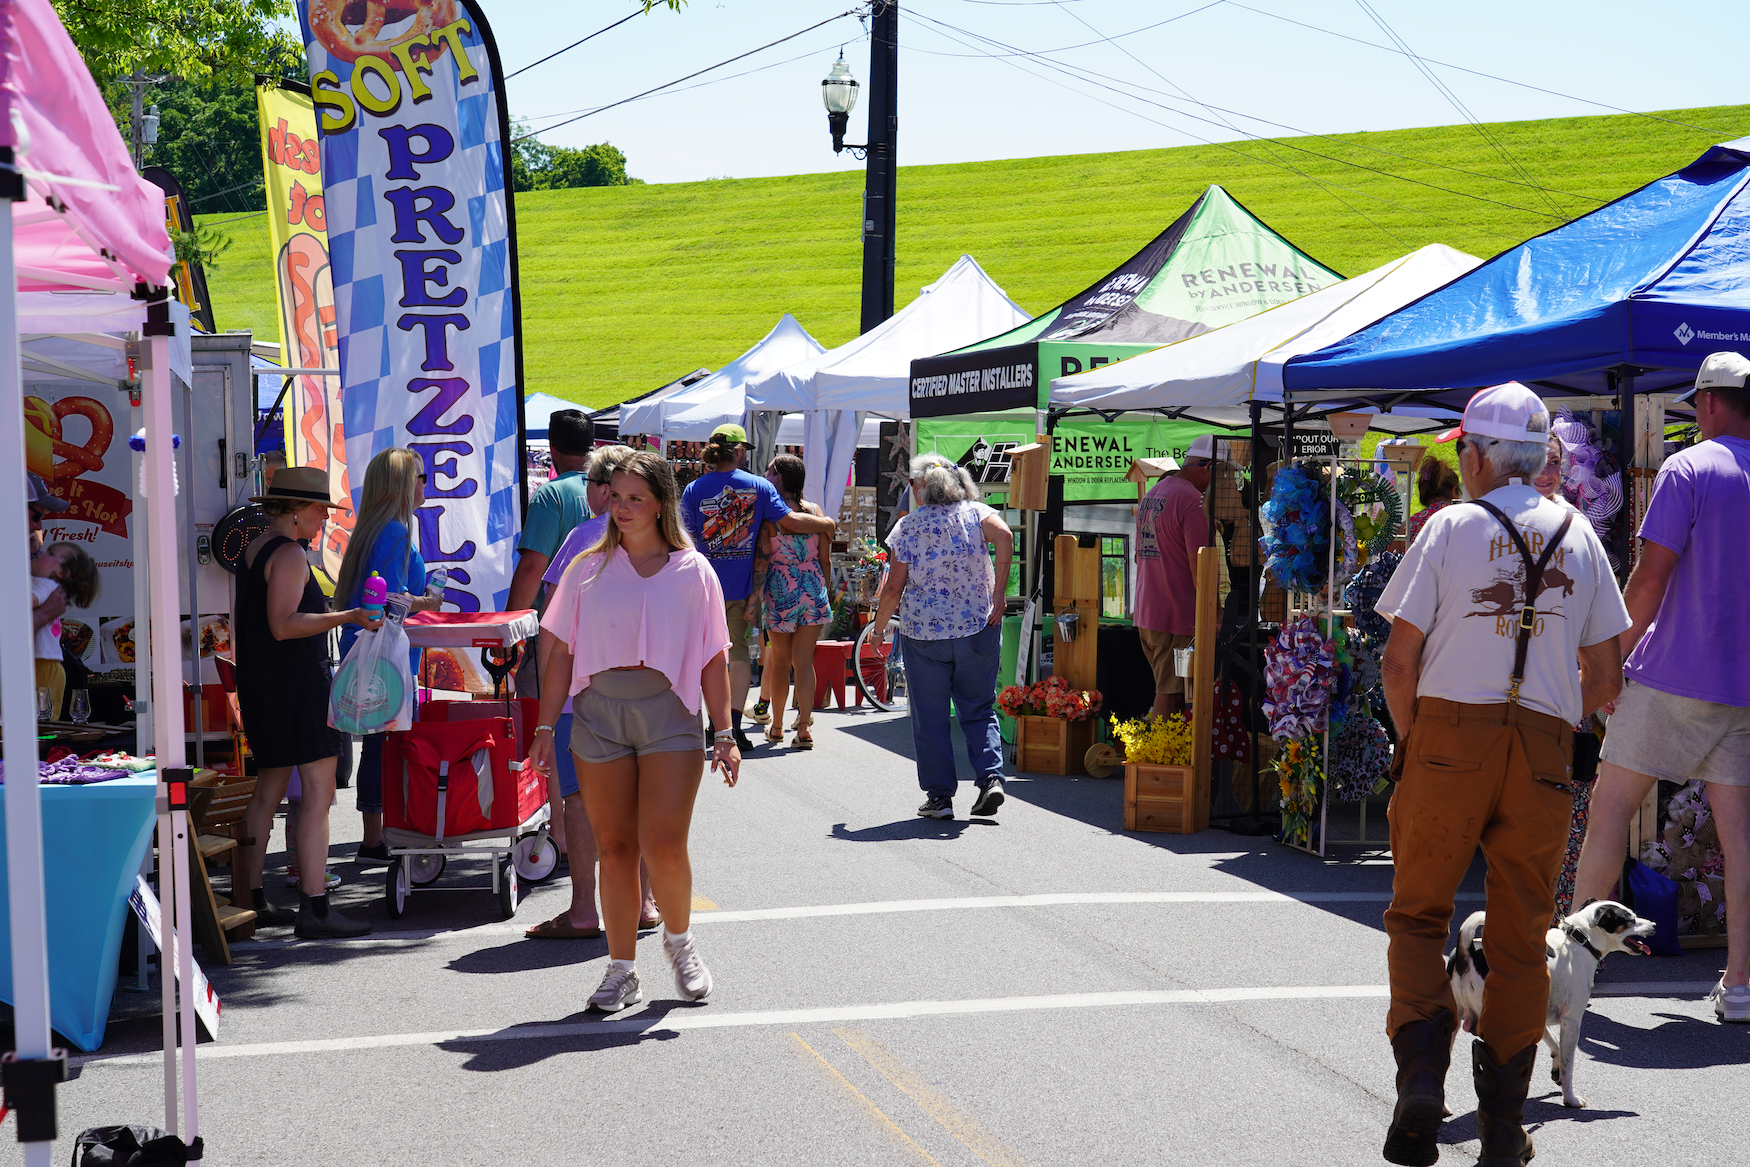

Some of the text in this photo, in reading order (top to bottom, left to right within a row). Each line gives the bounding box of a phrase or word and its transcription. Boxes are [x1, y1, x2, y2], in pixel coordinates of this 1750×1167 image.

[311, 17, 479, 136] SOFT
[1181, 262, 1317, 288] RENEWAL
[1188, 281, 1322, 299] by ANDERSEN
[1697, 330, 1739, 341] Member's
[911, 374, 948, 399] CERTIFIED
[948, 370, 981, 395] MASTER
[981, 363, 1033, 392] INSTALLERS
[1052, 436, 1133, 453] ENEWAL
[1145, 447, 1169, 459] The
[1053, 456, 1134, 469] ANDERSEN
[69, 480, 85, 498] It
[82, 499, 119, 524] Hot
[50, 526, 99, 543] Fresh!
